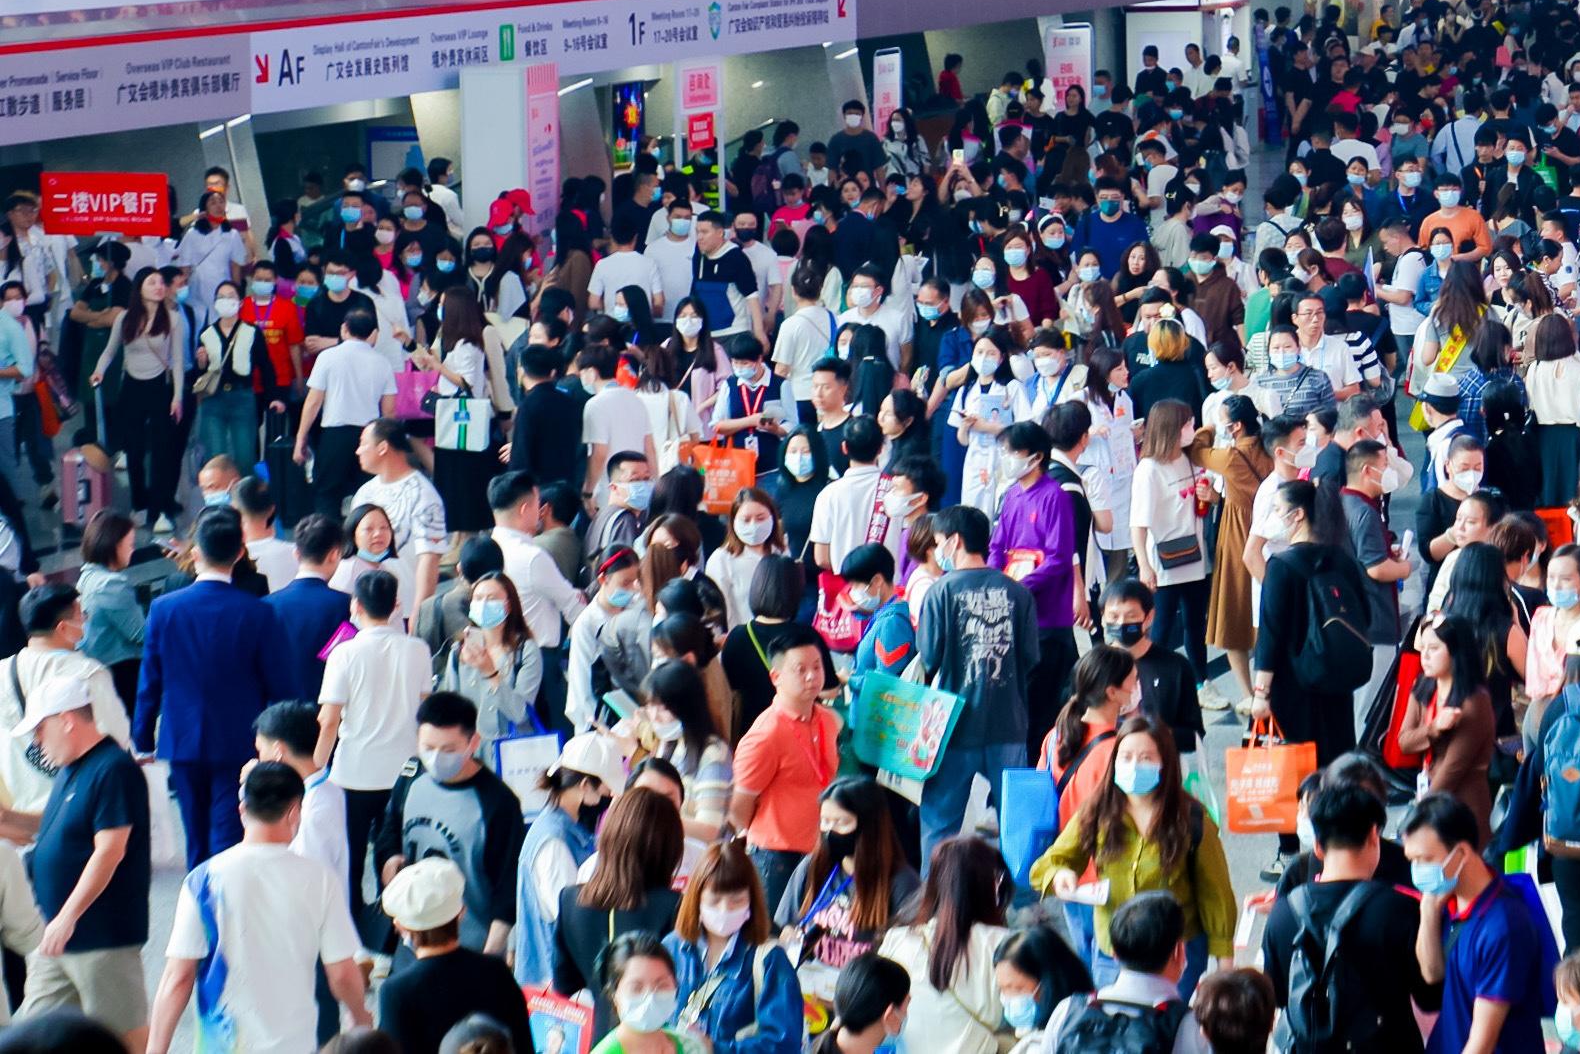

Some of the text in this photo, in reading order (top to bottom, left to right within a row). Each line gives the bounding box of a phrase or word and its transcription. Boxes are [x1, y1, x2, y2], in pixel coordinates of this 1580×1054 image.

[524, 39, 548, 58] 餐饮区
[125, 54, 232, 75] Overseas VIP Club Restaurant
[117, 72, 241, 106] 广交会境外贵宾俱乐部餐厅
[52, 192, 158, 216] 二楼VIP餐厅
